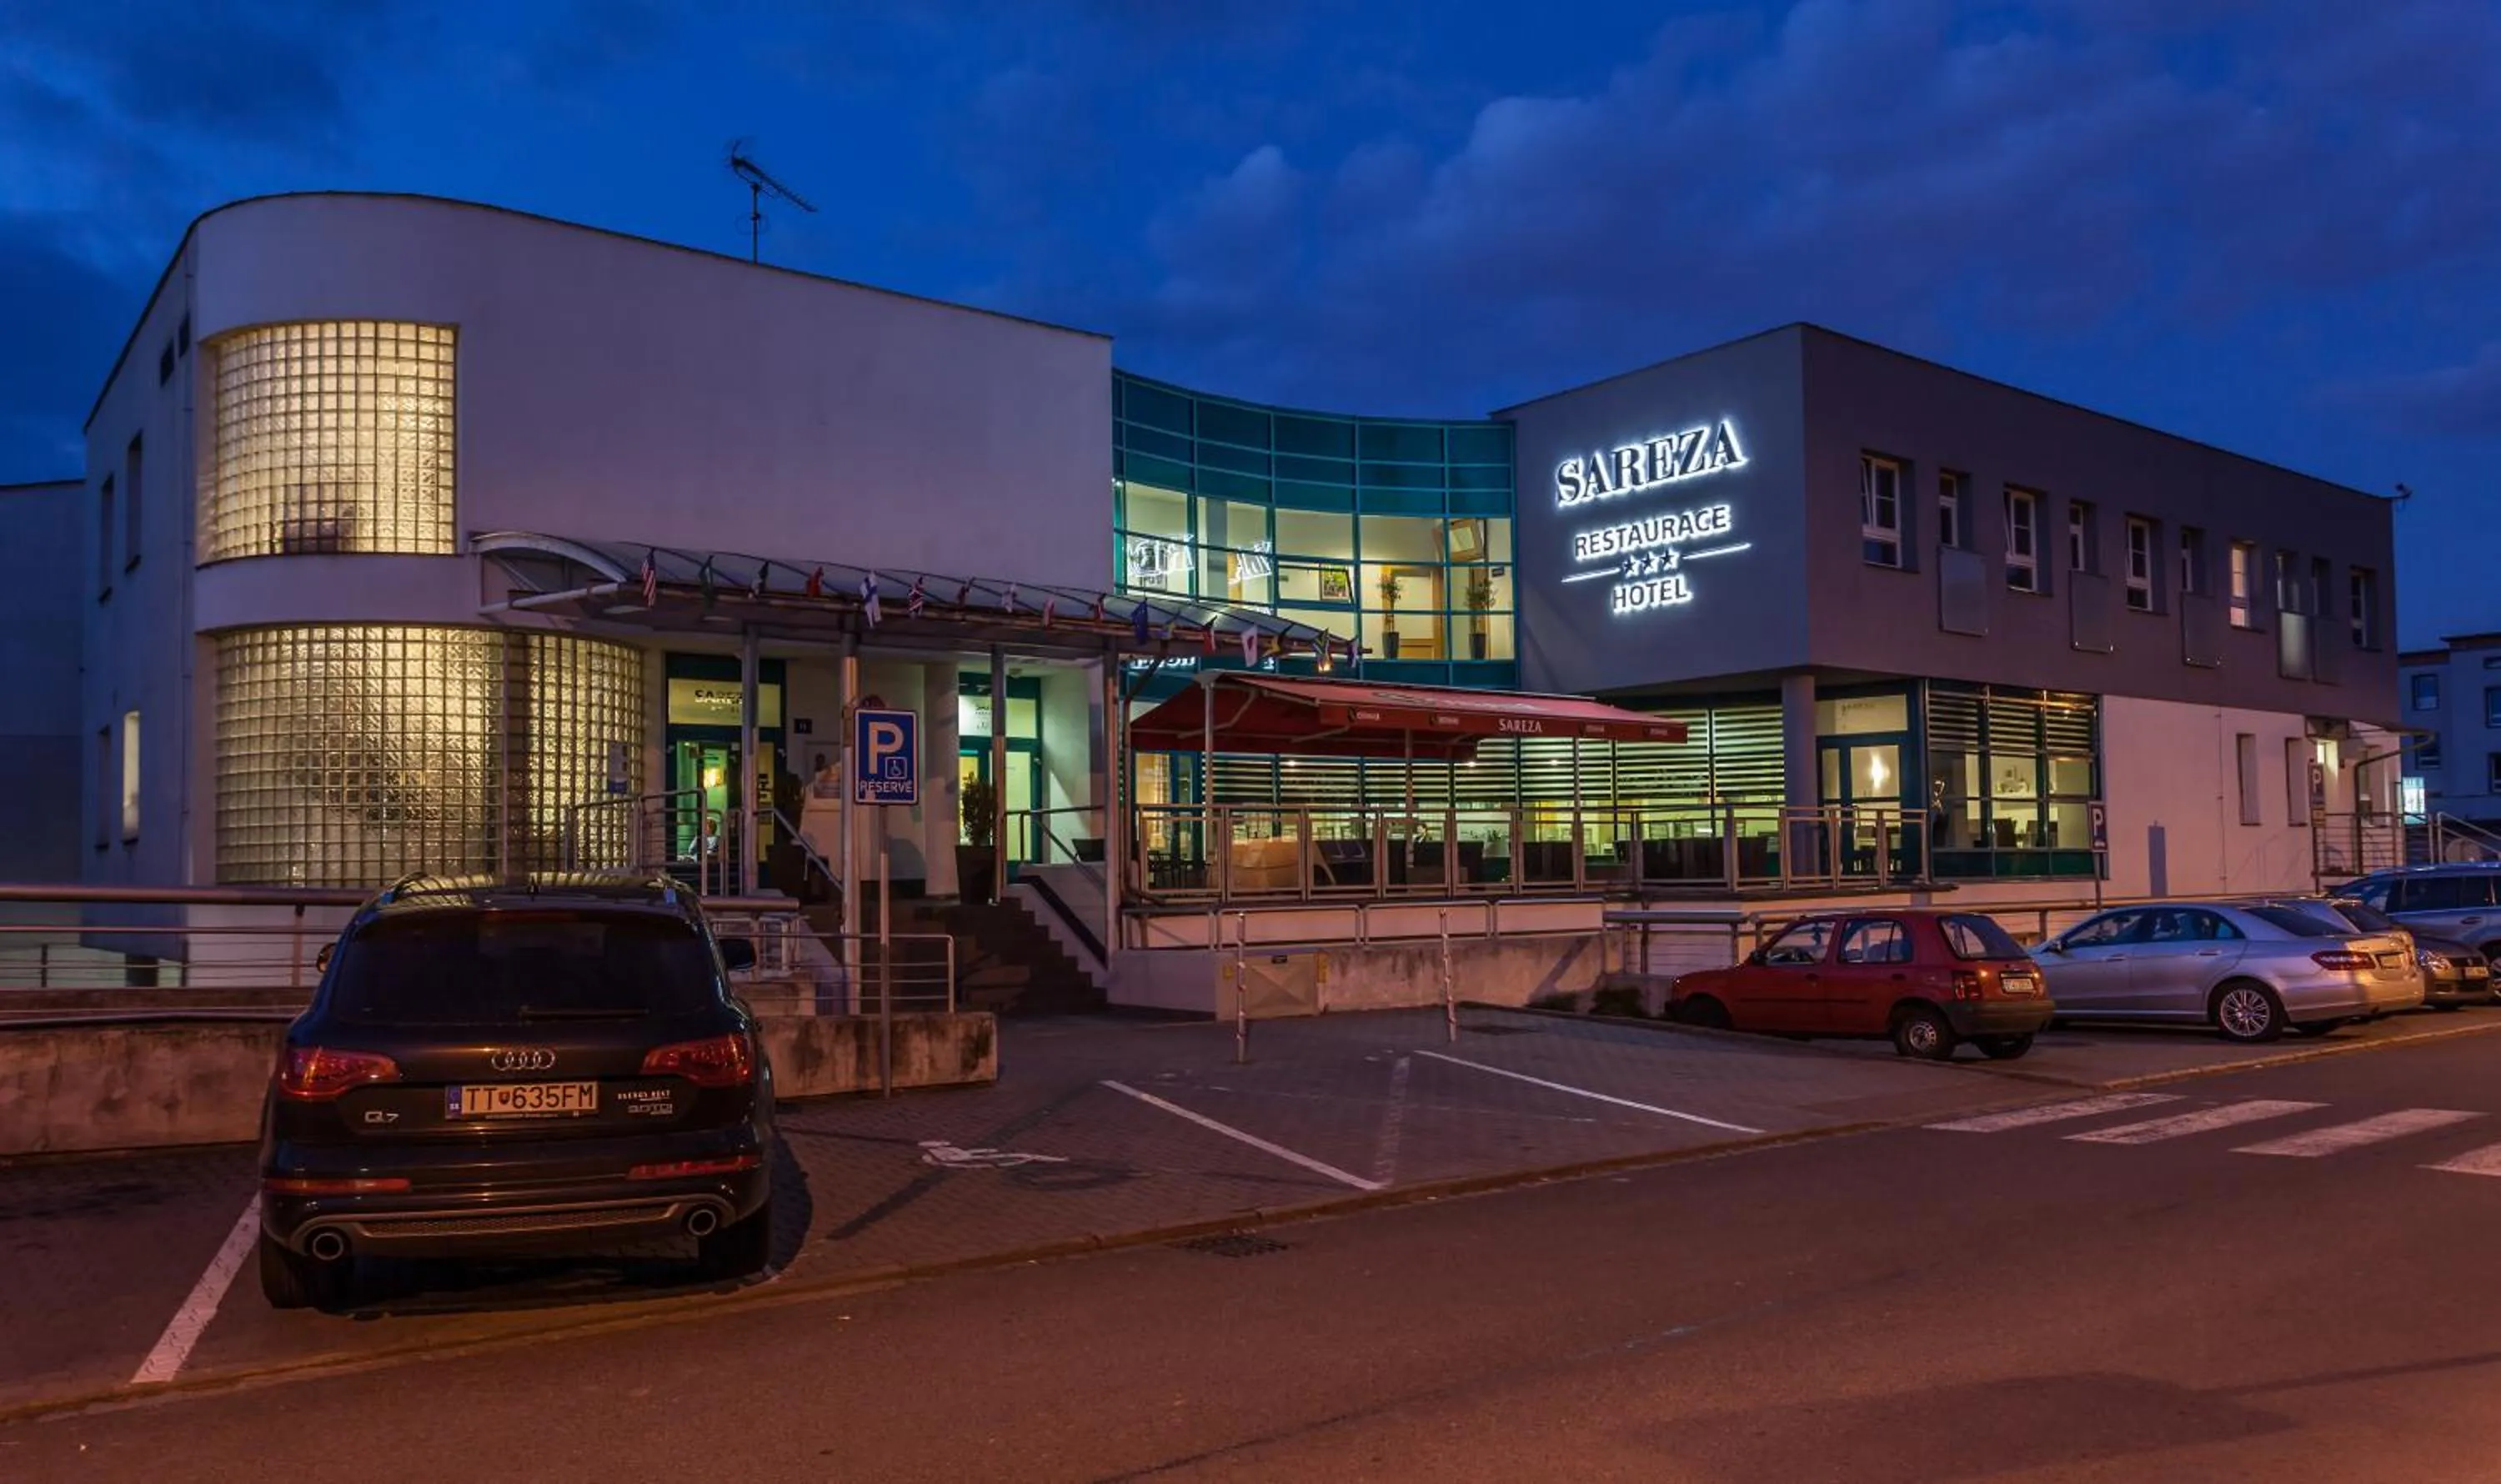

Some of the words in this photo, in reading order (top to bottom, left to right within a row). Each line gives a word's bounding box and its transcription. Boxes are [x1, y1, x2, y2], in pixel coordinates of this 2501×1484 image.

[1556, 420, 1746, 504] SAREZA
[1575, 504, 1730, 559] RESTAURACE
[1613, 578, 1691, 613] HOTEL
[868, 721, 905, 774] P
[1498, 718, 1542, 733] SAREZA
[2093, 808, 2103, 836] P
